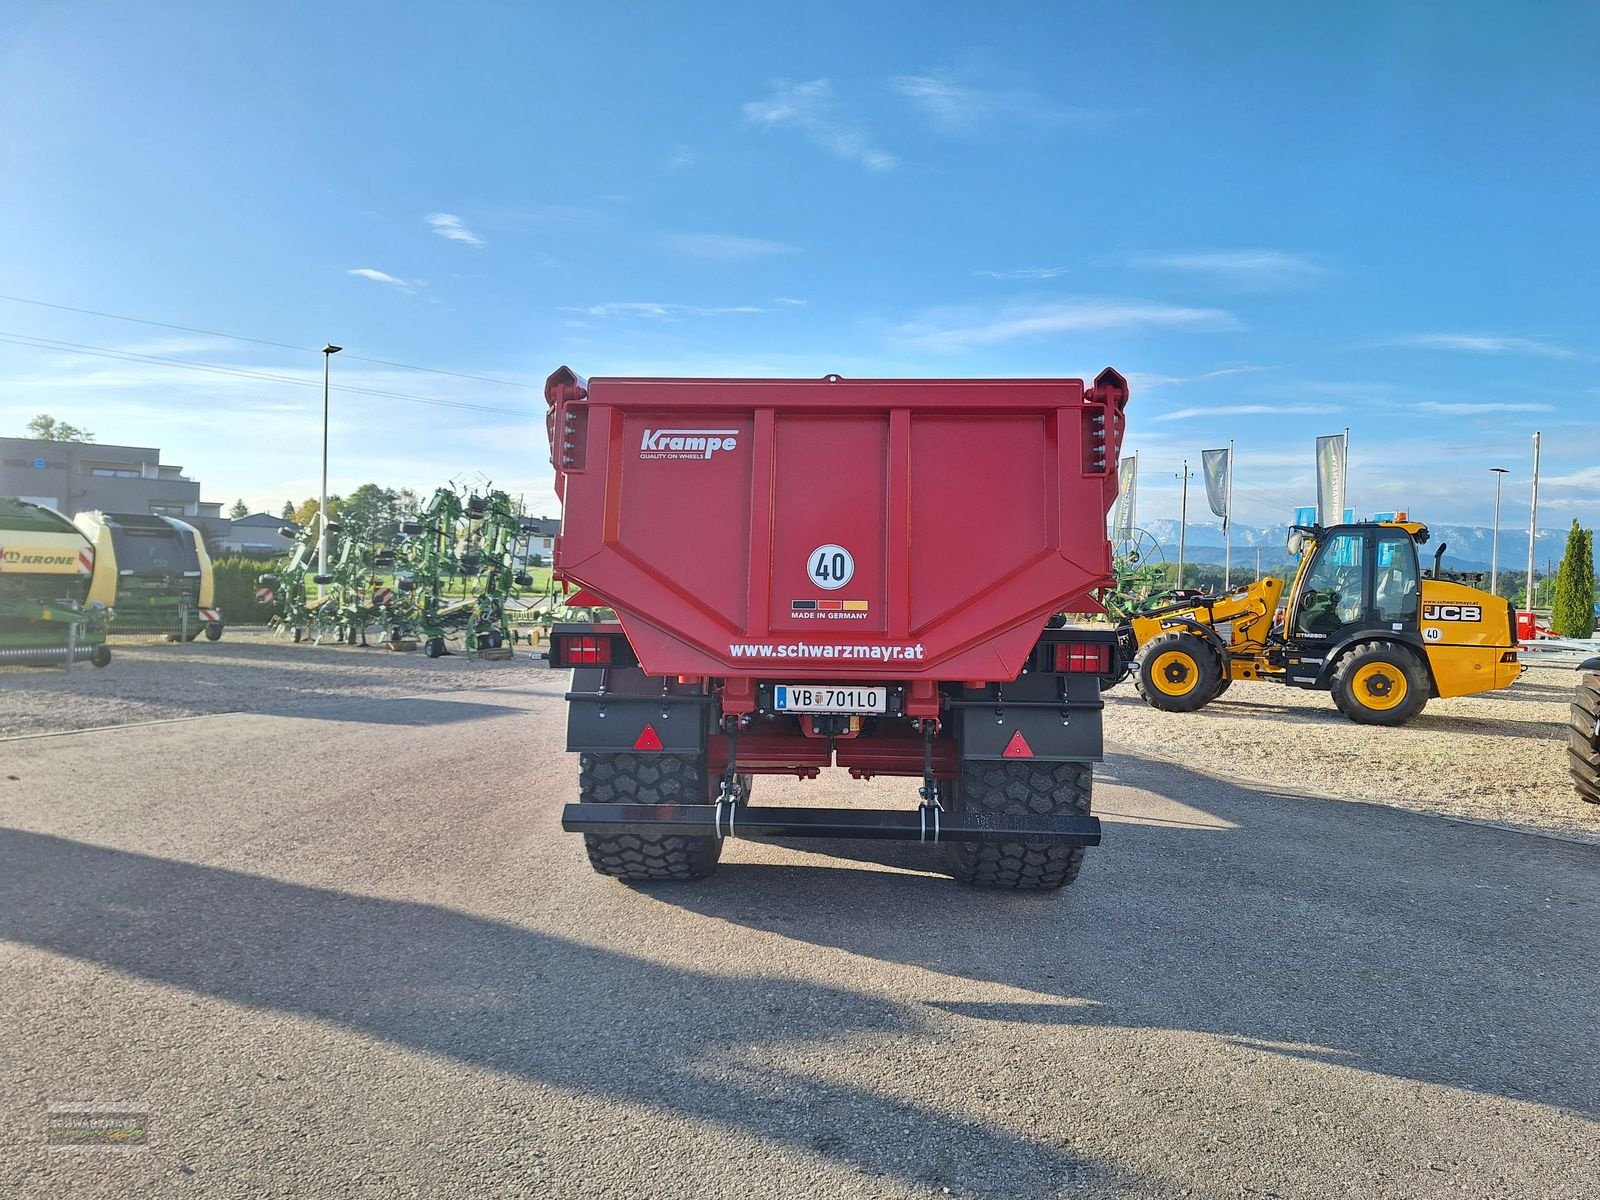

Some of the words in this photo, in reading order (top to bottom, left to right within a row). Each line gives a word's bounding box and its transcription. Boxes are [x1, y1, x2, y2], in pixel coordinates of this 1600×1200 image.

[640, 429, 740, 459] Krampe
[21, 555, 76, 566] KRONE
[814, 552, 846, 581] 40
[1424, 606, 1481, 621] JCB
[1427, 629, 1438, 639] 40
[729, 642, 924, 662] www.schwarzmayr.at
[792, 689, 812, 706] VB
